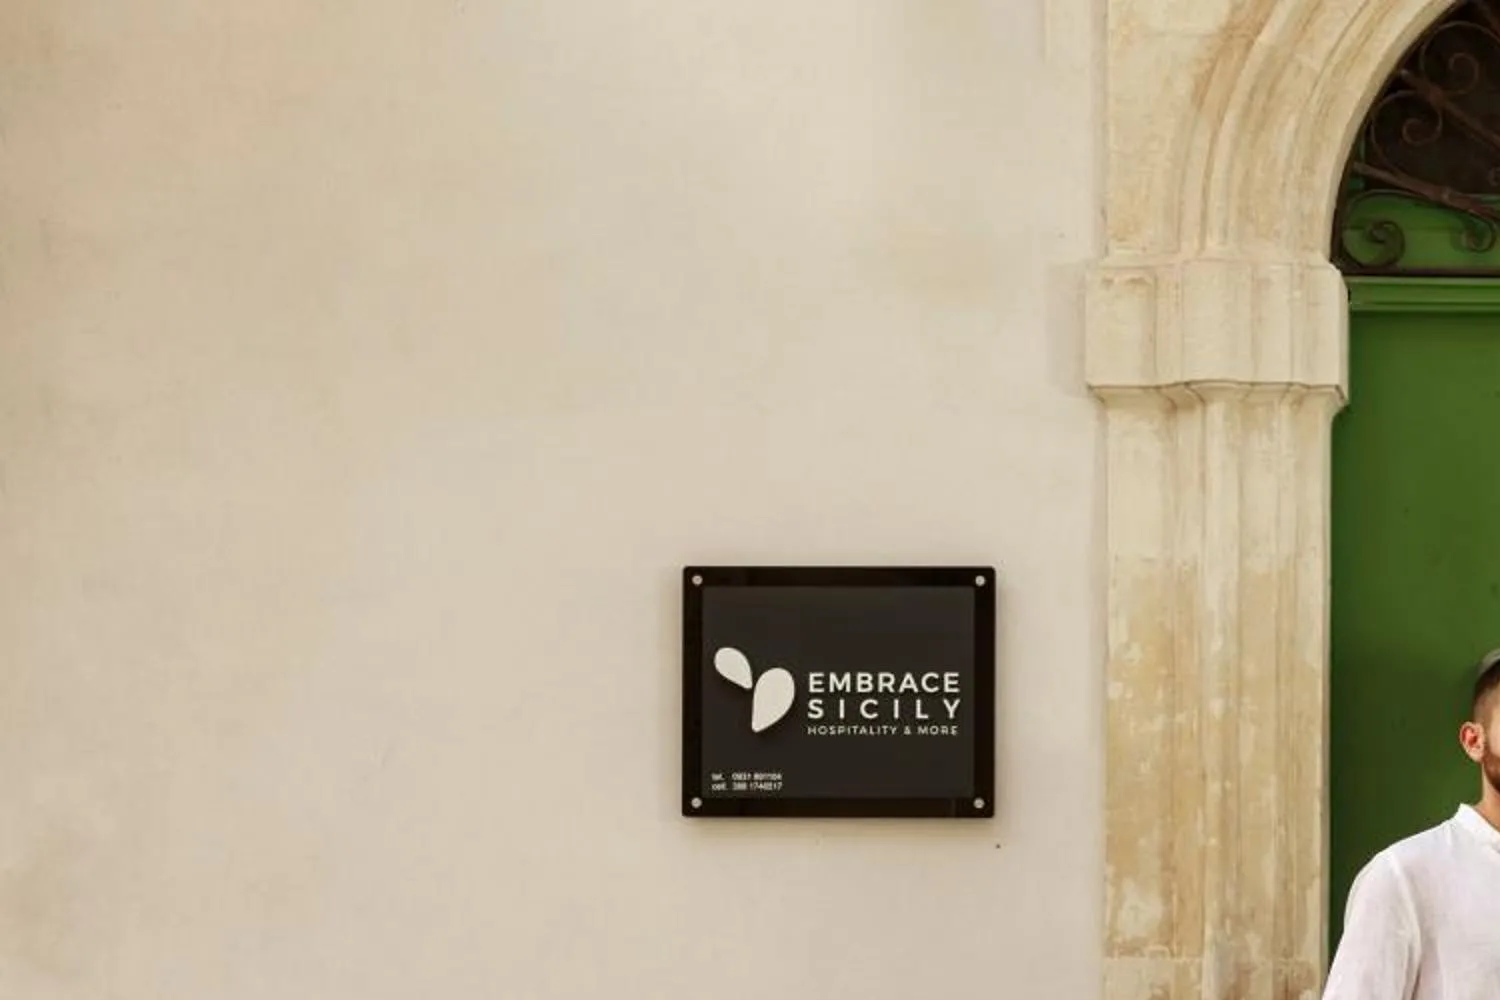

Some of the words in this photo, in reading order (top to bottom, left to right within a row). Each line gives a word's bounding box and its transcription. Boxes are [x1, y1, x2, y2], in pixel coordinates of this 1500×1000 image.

[808, 671, 960, 693] EMBRACE
[807, 698, 961, 719] SICILY
[807, 724, 897, 736] HOSPITALITY
[903, 724, 911, 736] &
[917, 724, 958, 736] MORE
